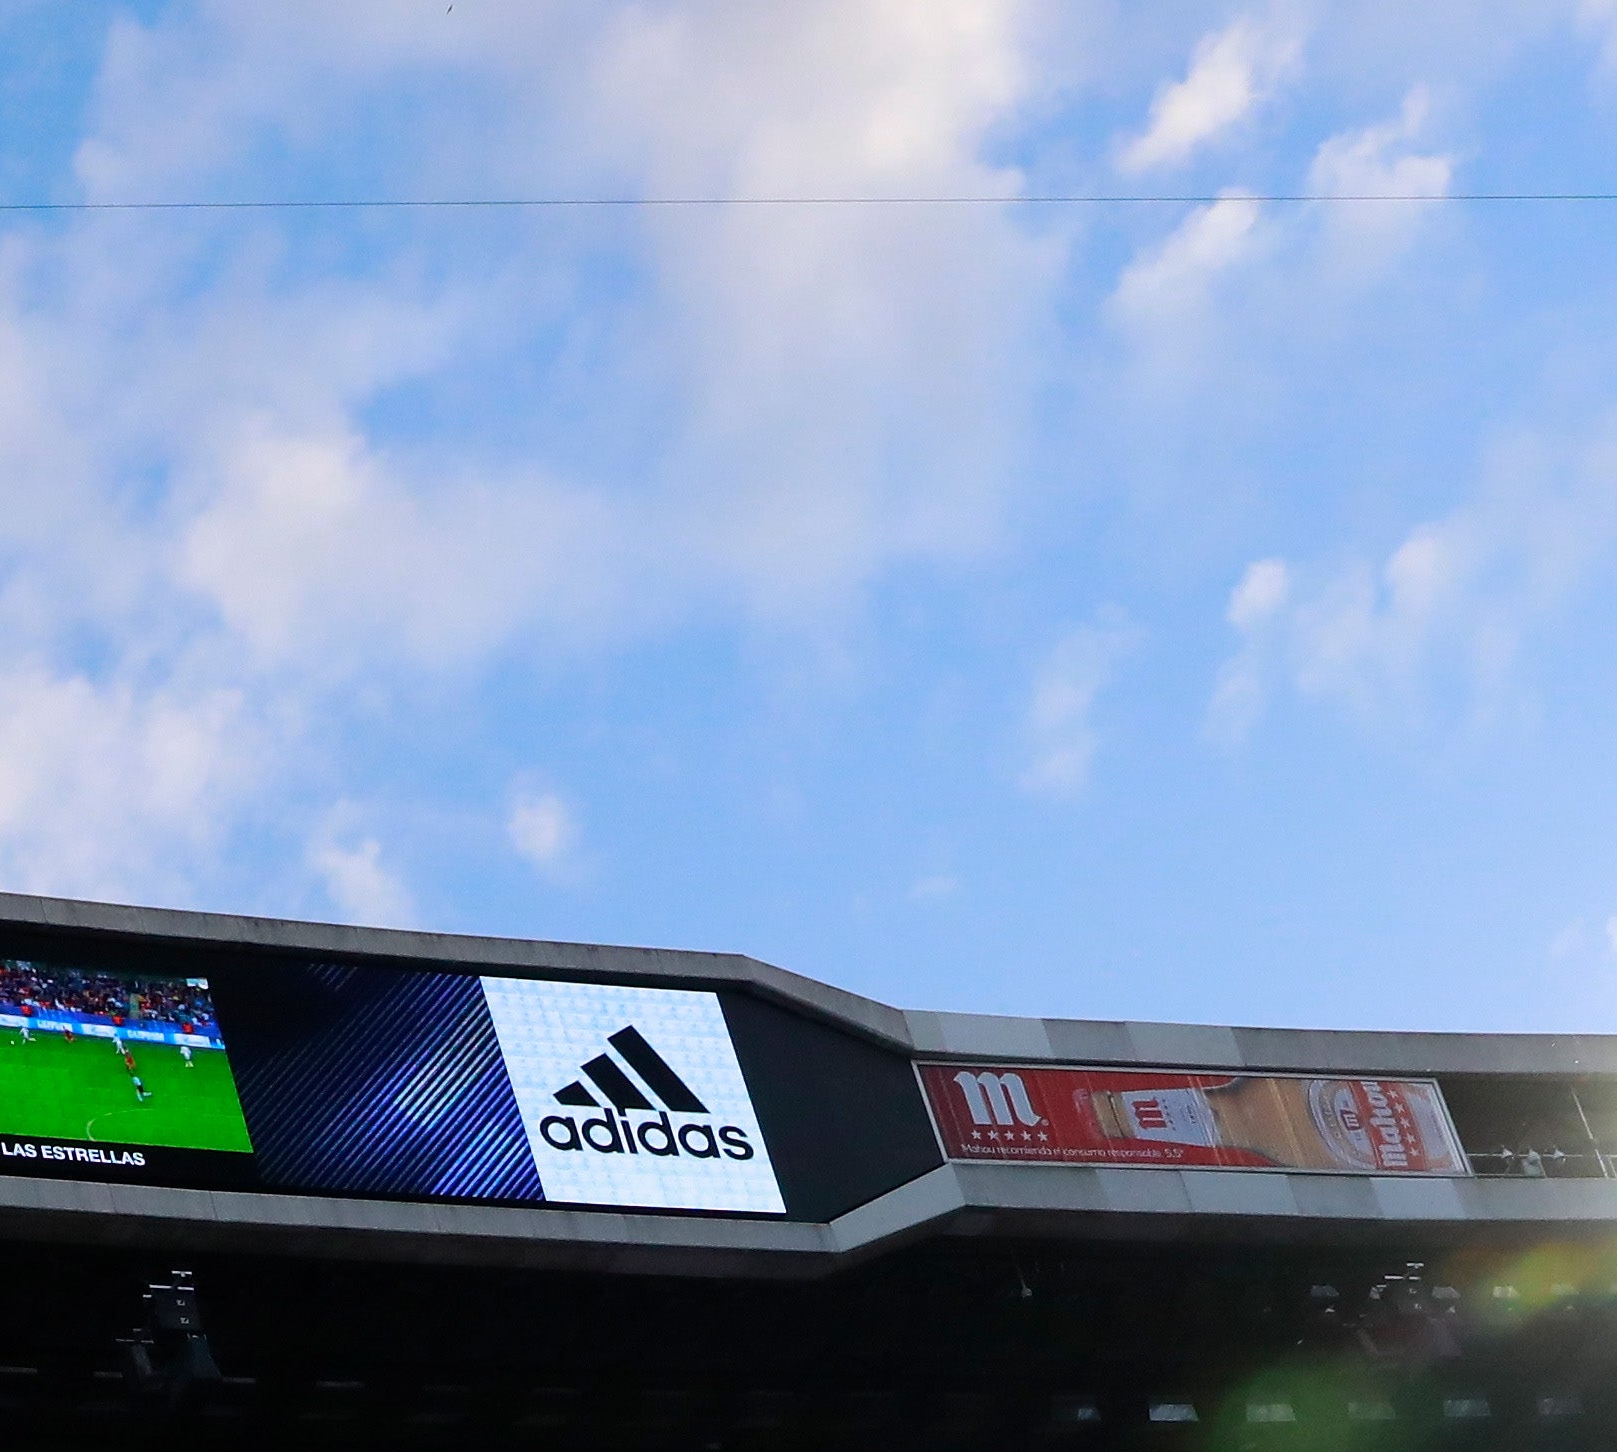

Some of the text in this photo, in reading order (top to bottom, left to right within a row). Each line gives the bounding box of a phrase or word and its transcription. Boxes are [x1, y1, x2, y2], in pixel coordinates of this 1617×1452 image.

[540, 1107, 755, 1161] adidas
[1, 1142, 38, 1158] LAS
[40, 1145, 146, 1166] ESTRELLAS
